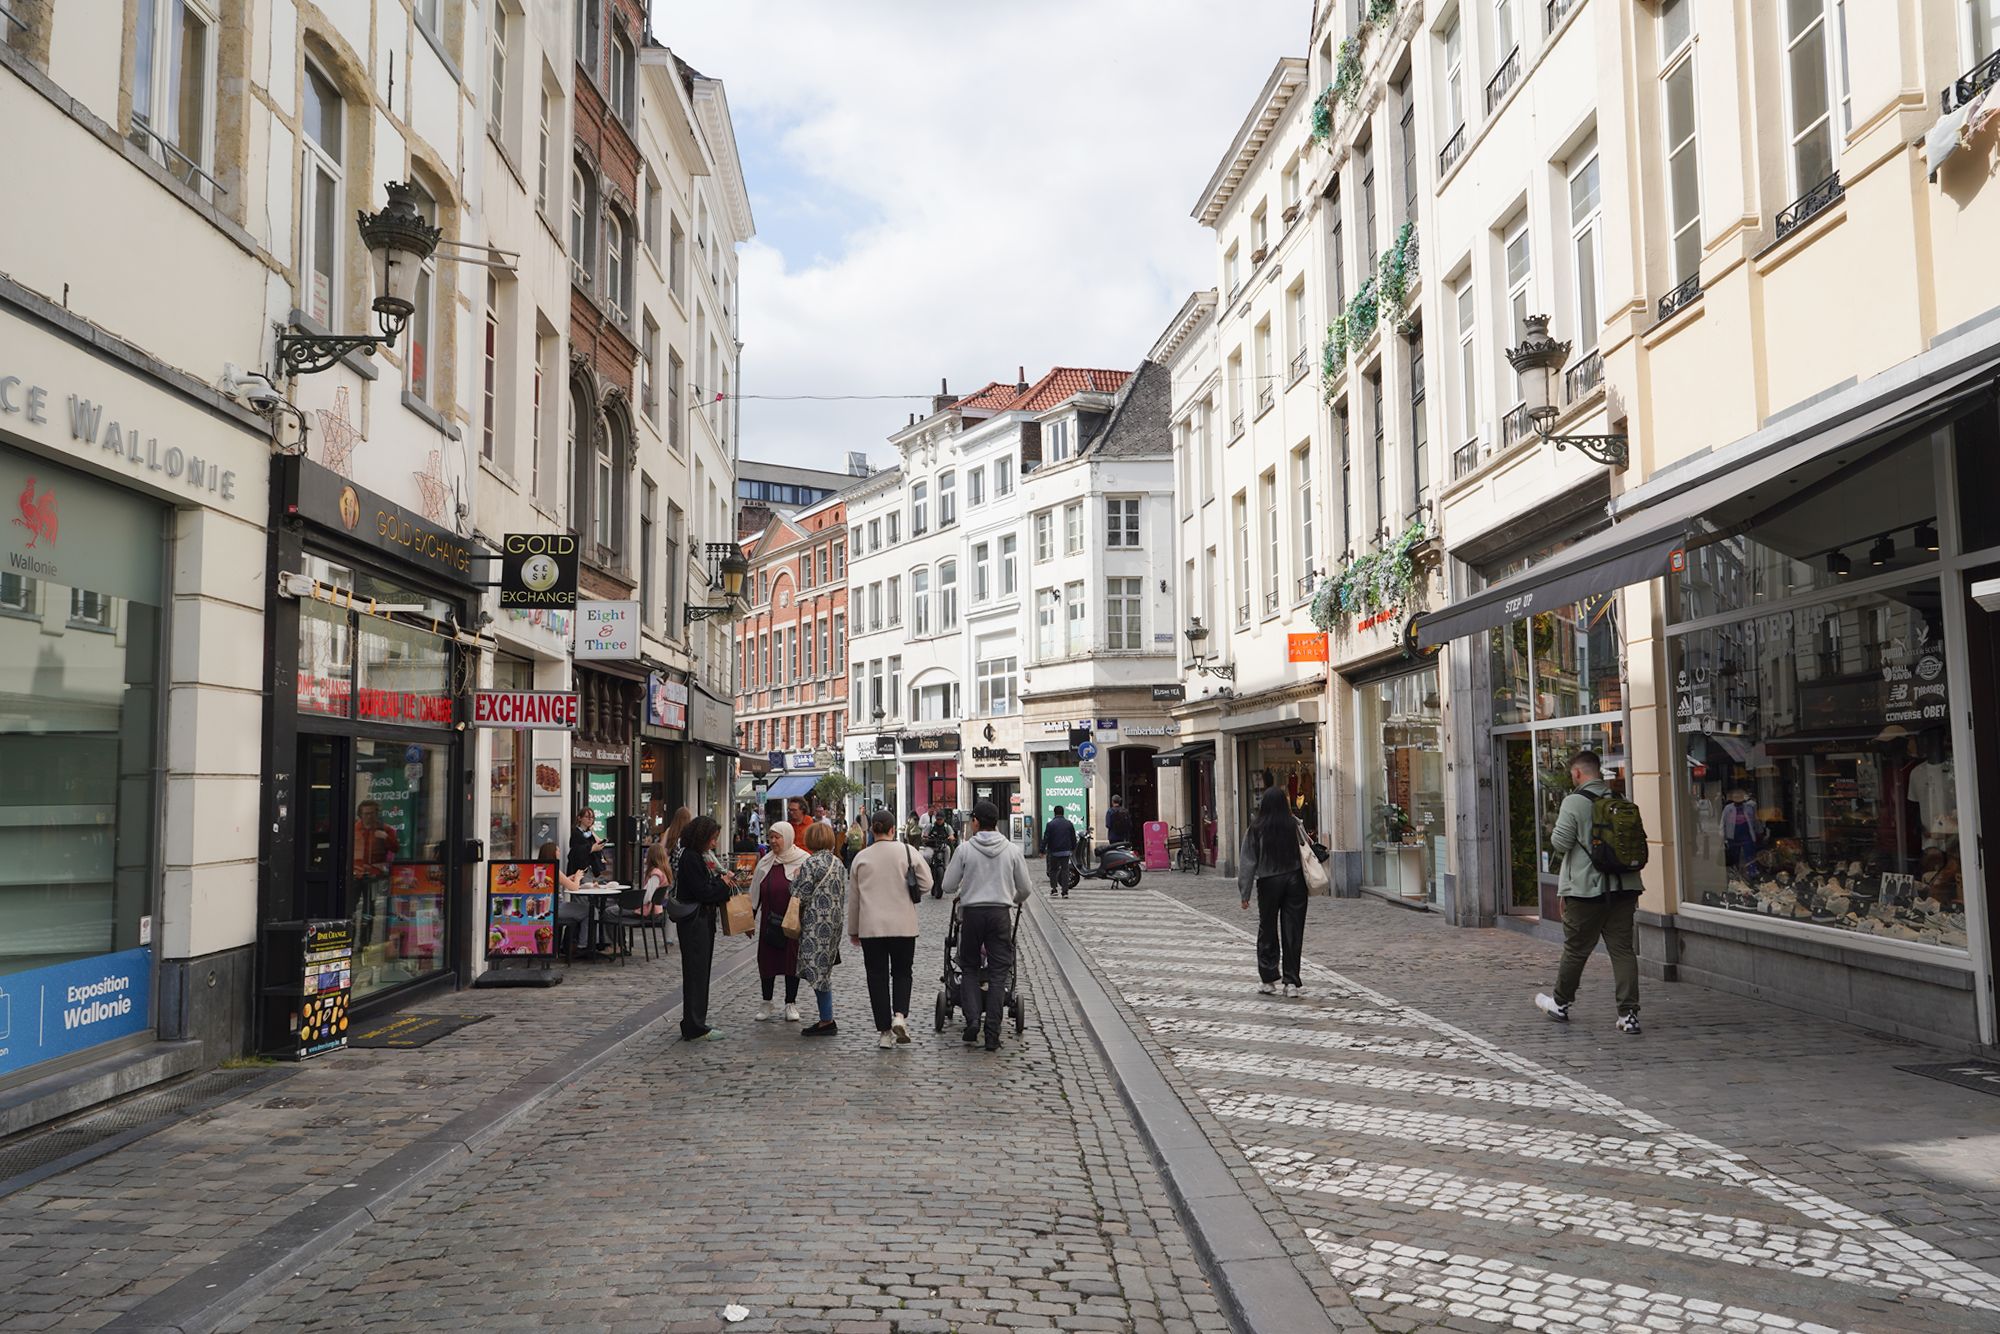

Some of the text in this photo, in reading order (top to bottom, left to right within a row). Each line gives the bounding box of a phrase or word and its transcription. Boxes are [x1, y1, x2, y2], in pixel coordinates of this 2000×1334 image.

[68, 393, 236, 501] WALLONIE
[376, 511, 473, 573] GOLD EXCHANGE
[506, 535, 574, 555] GOLD
[10, 551, 58, 577] Wallonie
[501, 591, 575, 604] EXCHANGE
[1505, 593, 1533, 613] STEP UP
[587, 610, 625, 623] Eight
[1744, 606, 1826, 646] STEP UP
[599, 625, 613, 637] &
[585, 640, 627, 650] Three
[320, 678, 351, 698] CHANGE
[360, 688, 399, 718] BUREAU
[404, 694, 415, 719] DE
[420, 697, 453, 723] CHANGE
[475, 694, 577, 724] EXCHANGE
[1923, 704, 1946, 718] OBEY
[1886, 711, 1921, 721] CONVERSE
[1124, 726, 1164, 736] Timberland
[919, 739, 938, 750] Amaya
[1046, 788, 1083, 797] DESTOCKAGE
[68, 975, 129, 1004] Exposition
[64, 994, 131, 1030] Wallonie
